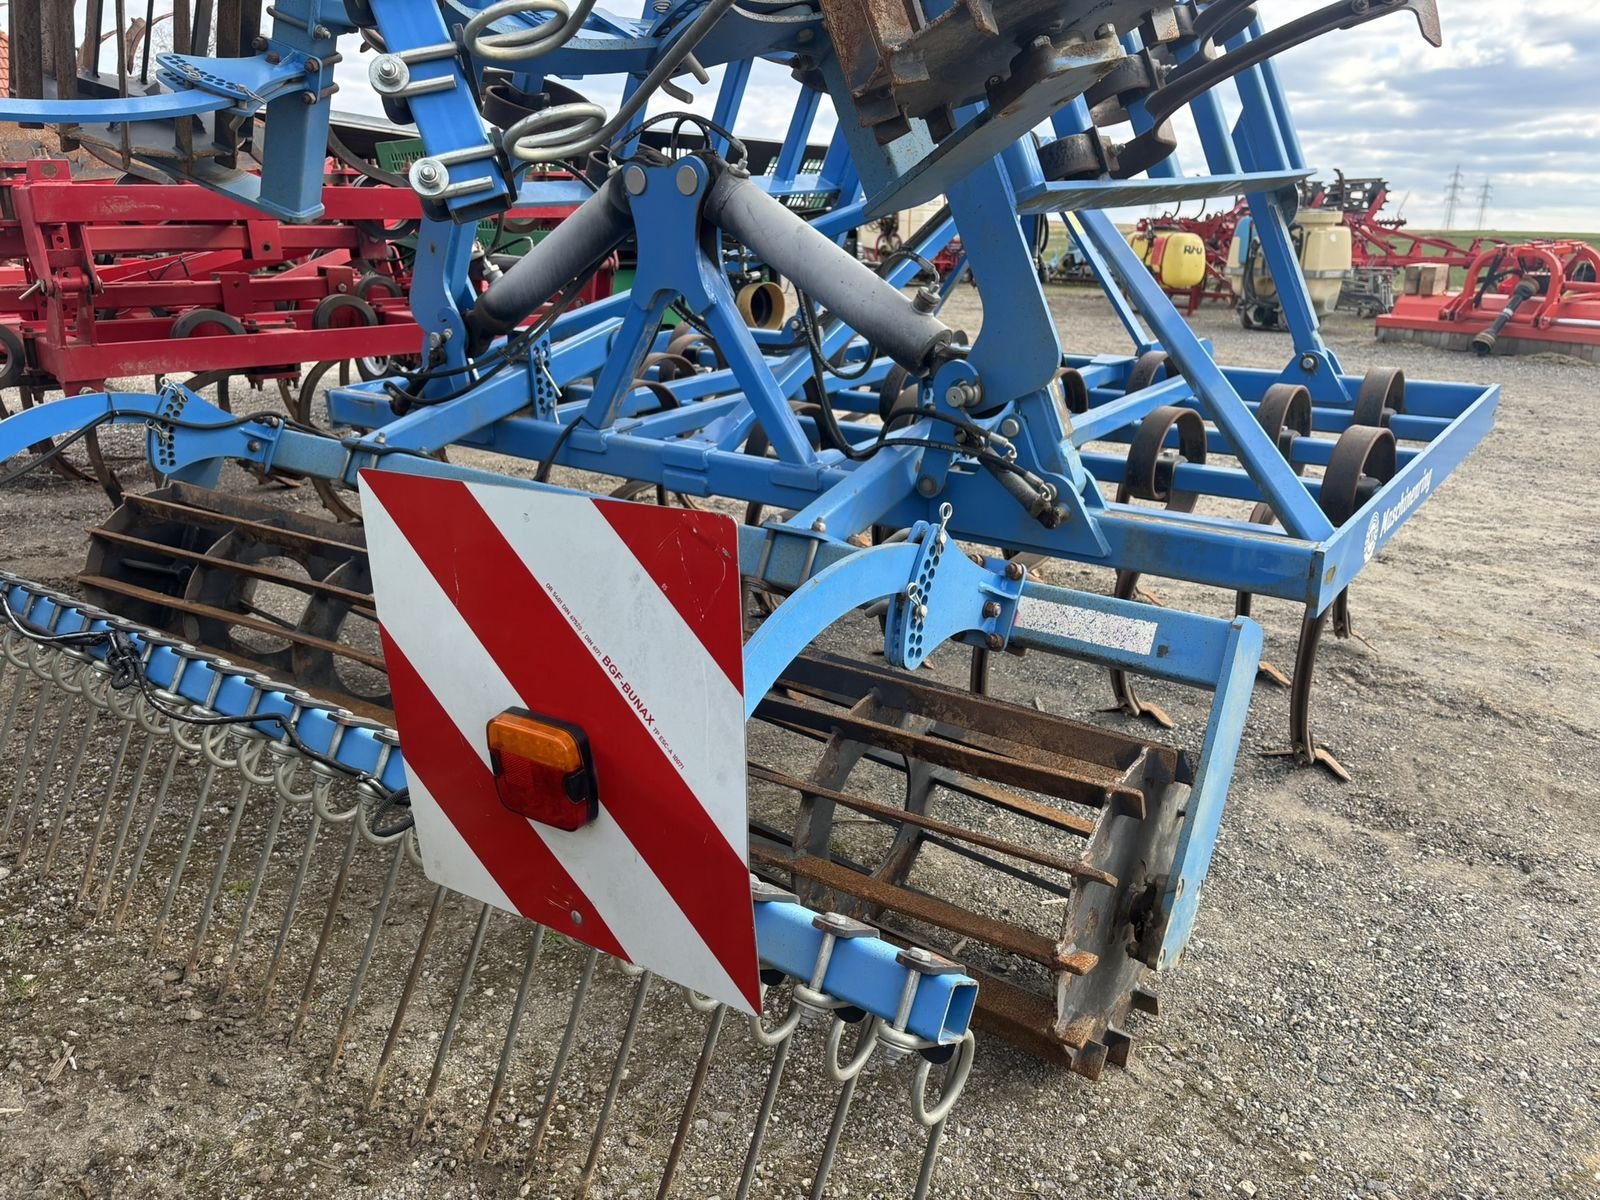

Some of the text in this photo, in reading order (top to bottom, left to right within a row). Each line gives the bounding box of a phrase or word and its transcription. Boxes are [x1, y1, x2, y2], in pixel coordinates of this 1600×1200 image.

[562, 603, 571, 616] DIN
[584, 634, 594, 647] DIN
[601, 655, 656, 726] BGF-BUNAX
